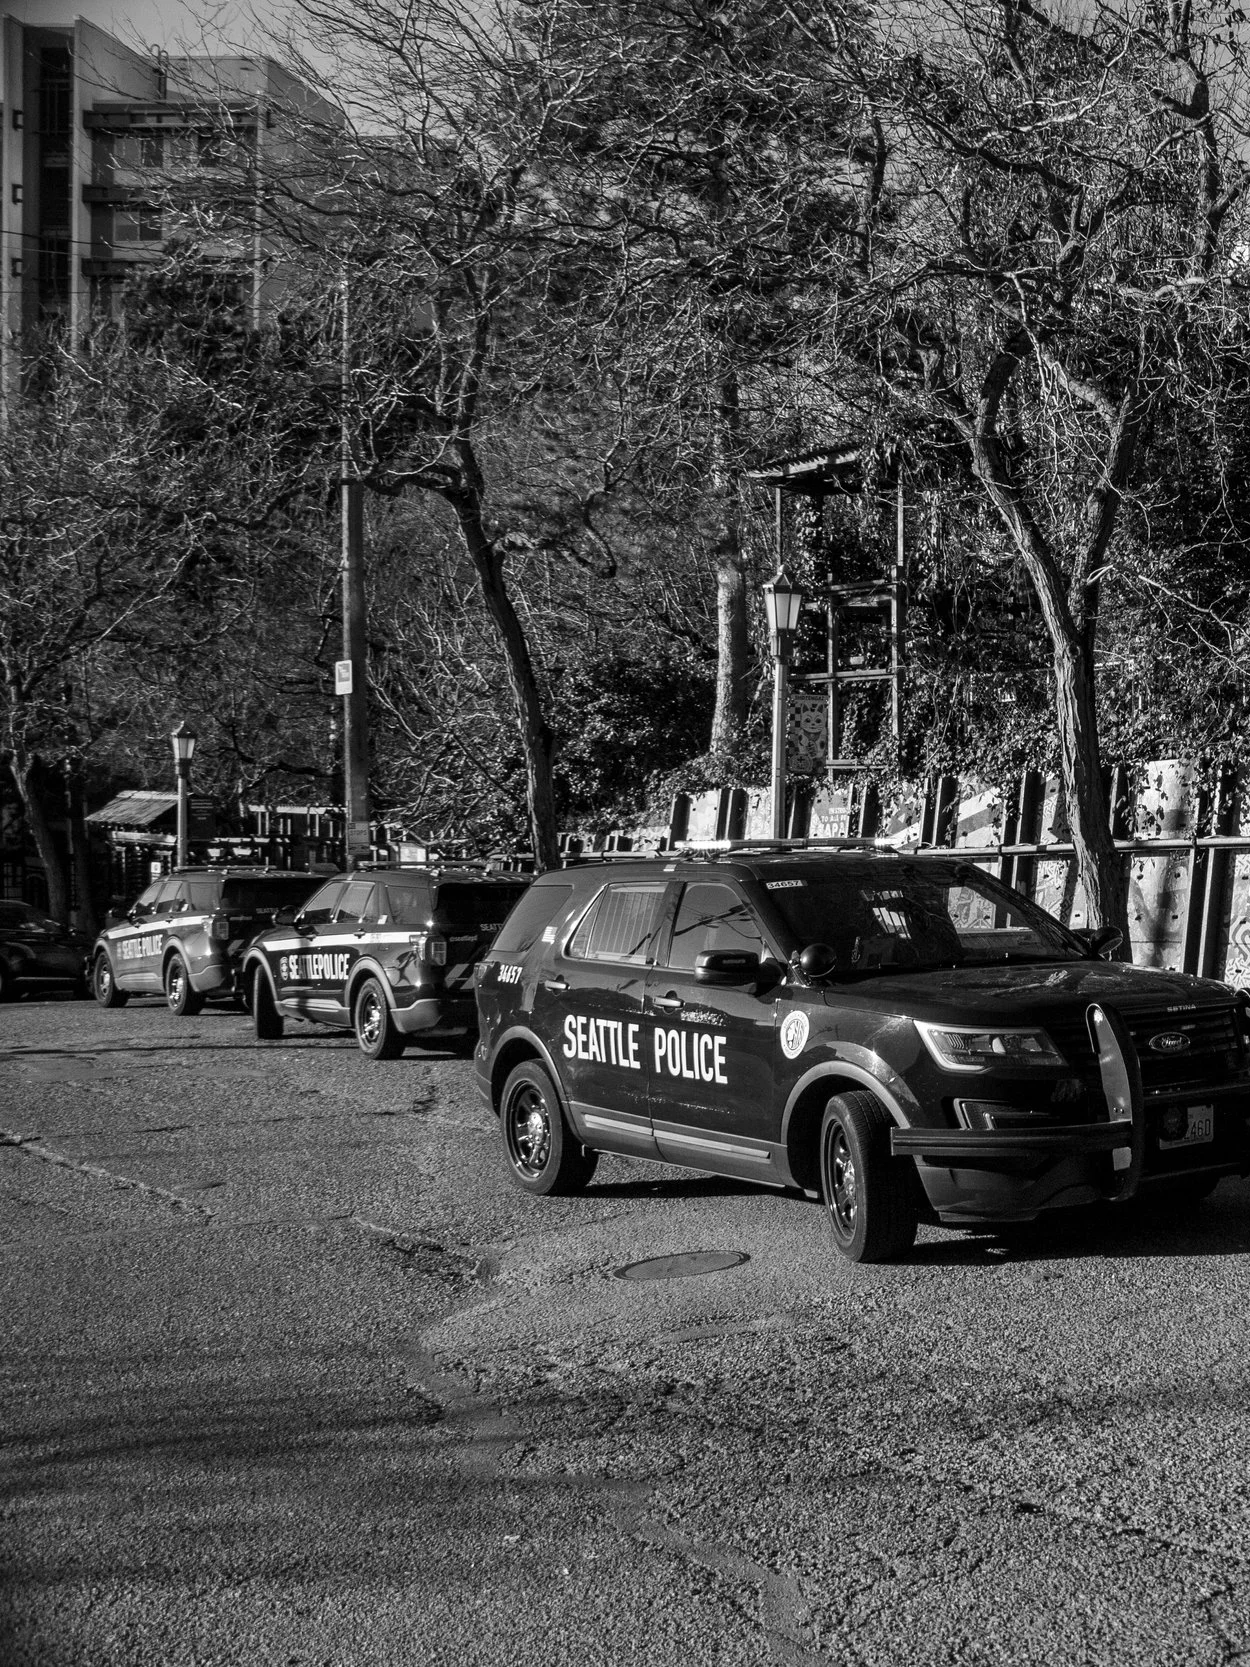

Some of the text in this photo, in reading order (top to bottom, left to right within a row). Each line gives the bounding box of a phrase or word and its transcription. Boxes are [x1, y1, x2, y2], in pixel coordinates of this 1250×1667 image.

[767, 880, 801, 889] 34657
[497, 964, 523, 984] 34657
[563, 1014, 641, 1070] SEATTLE
[654, 1027, 728, 1085] POLICE
